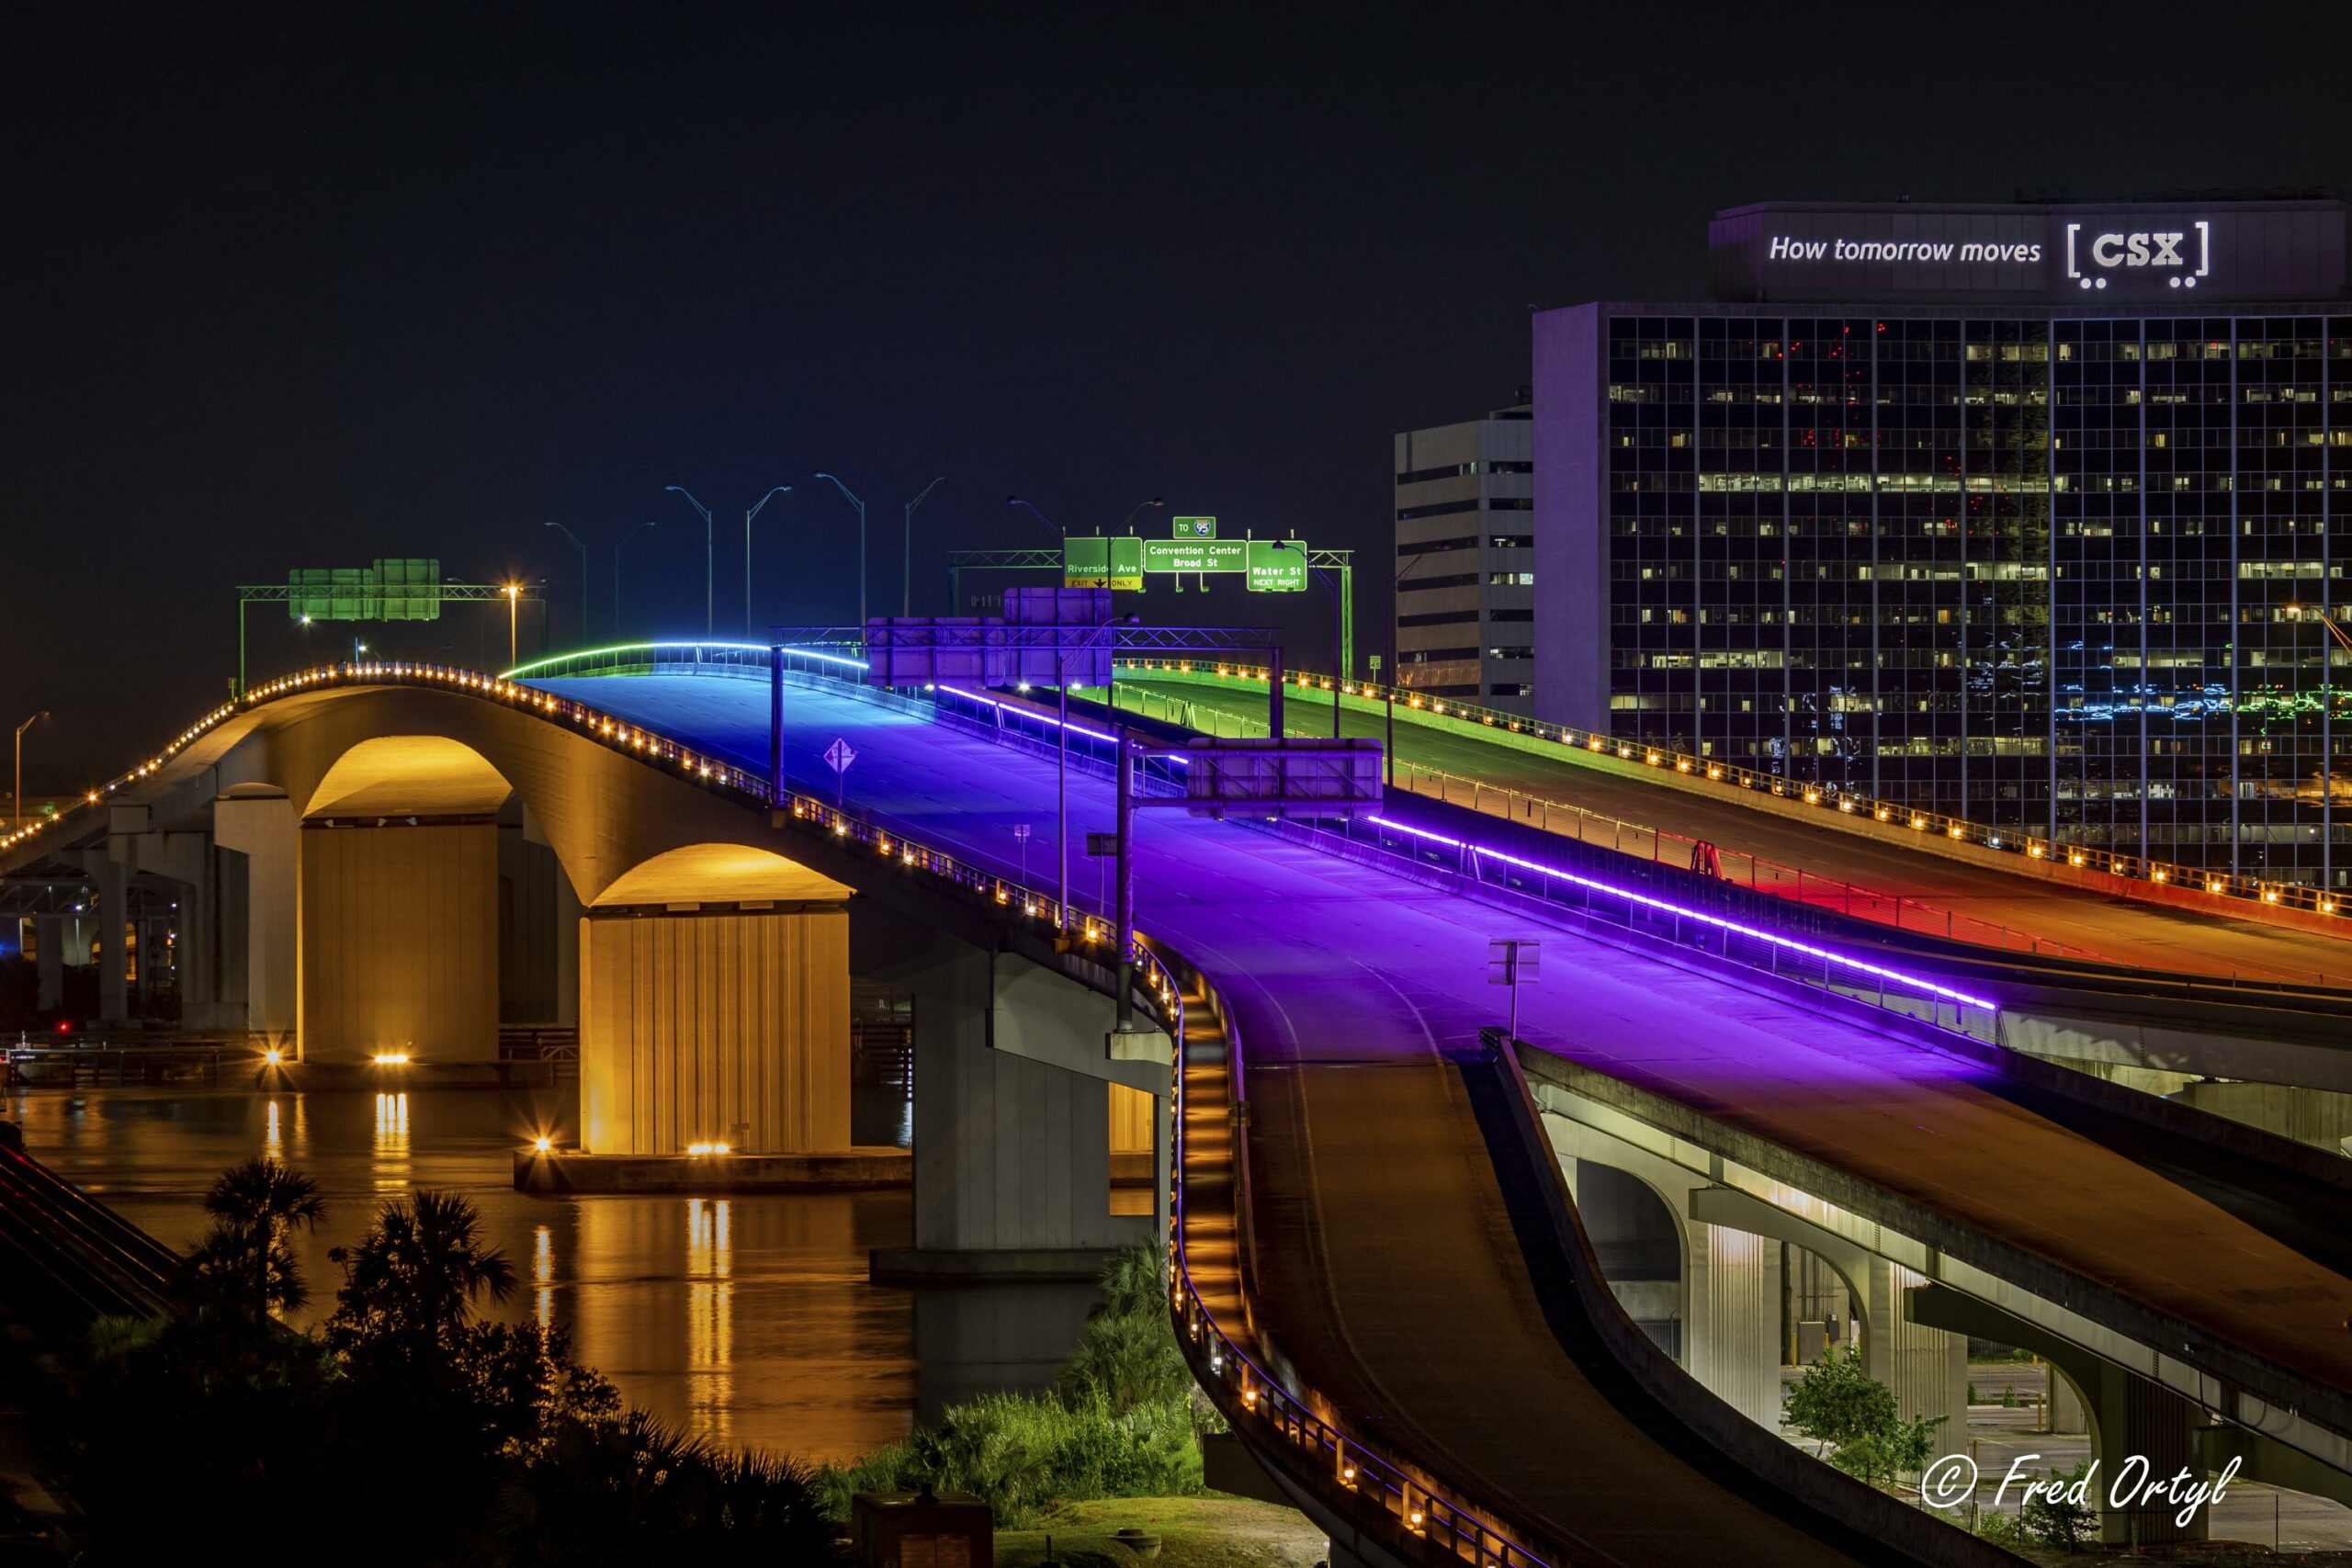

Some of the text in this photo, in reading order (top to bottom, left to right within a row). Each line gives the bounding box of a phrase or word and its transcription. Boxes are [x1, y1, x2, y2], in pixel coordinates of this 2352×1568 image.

[1770, 236, 2041, 262] How tomorrow moves
[2093, 233, 2183, 266] CSX
[1179, 524, 1208, 533] TO 95
[1149, 547, 1241, 555] Convention Center
[1173, 558, 1218, 567] Broad St
[1117, 564, 1137, 573] Ave
[1252, 567, 1302, 576] Water St
